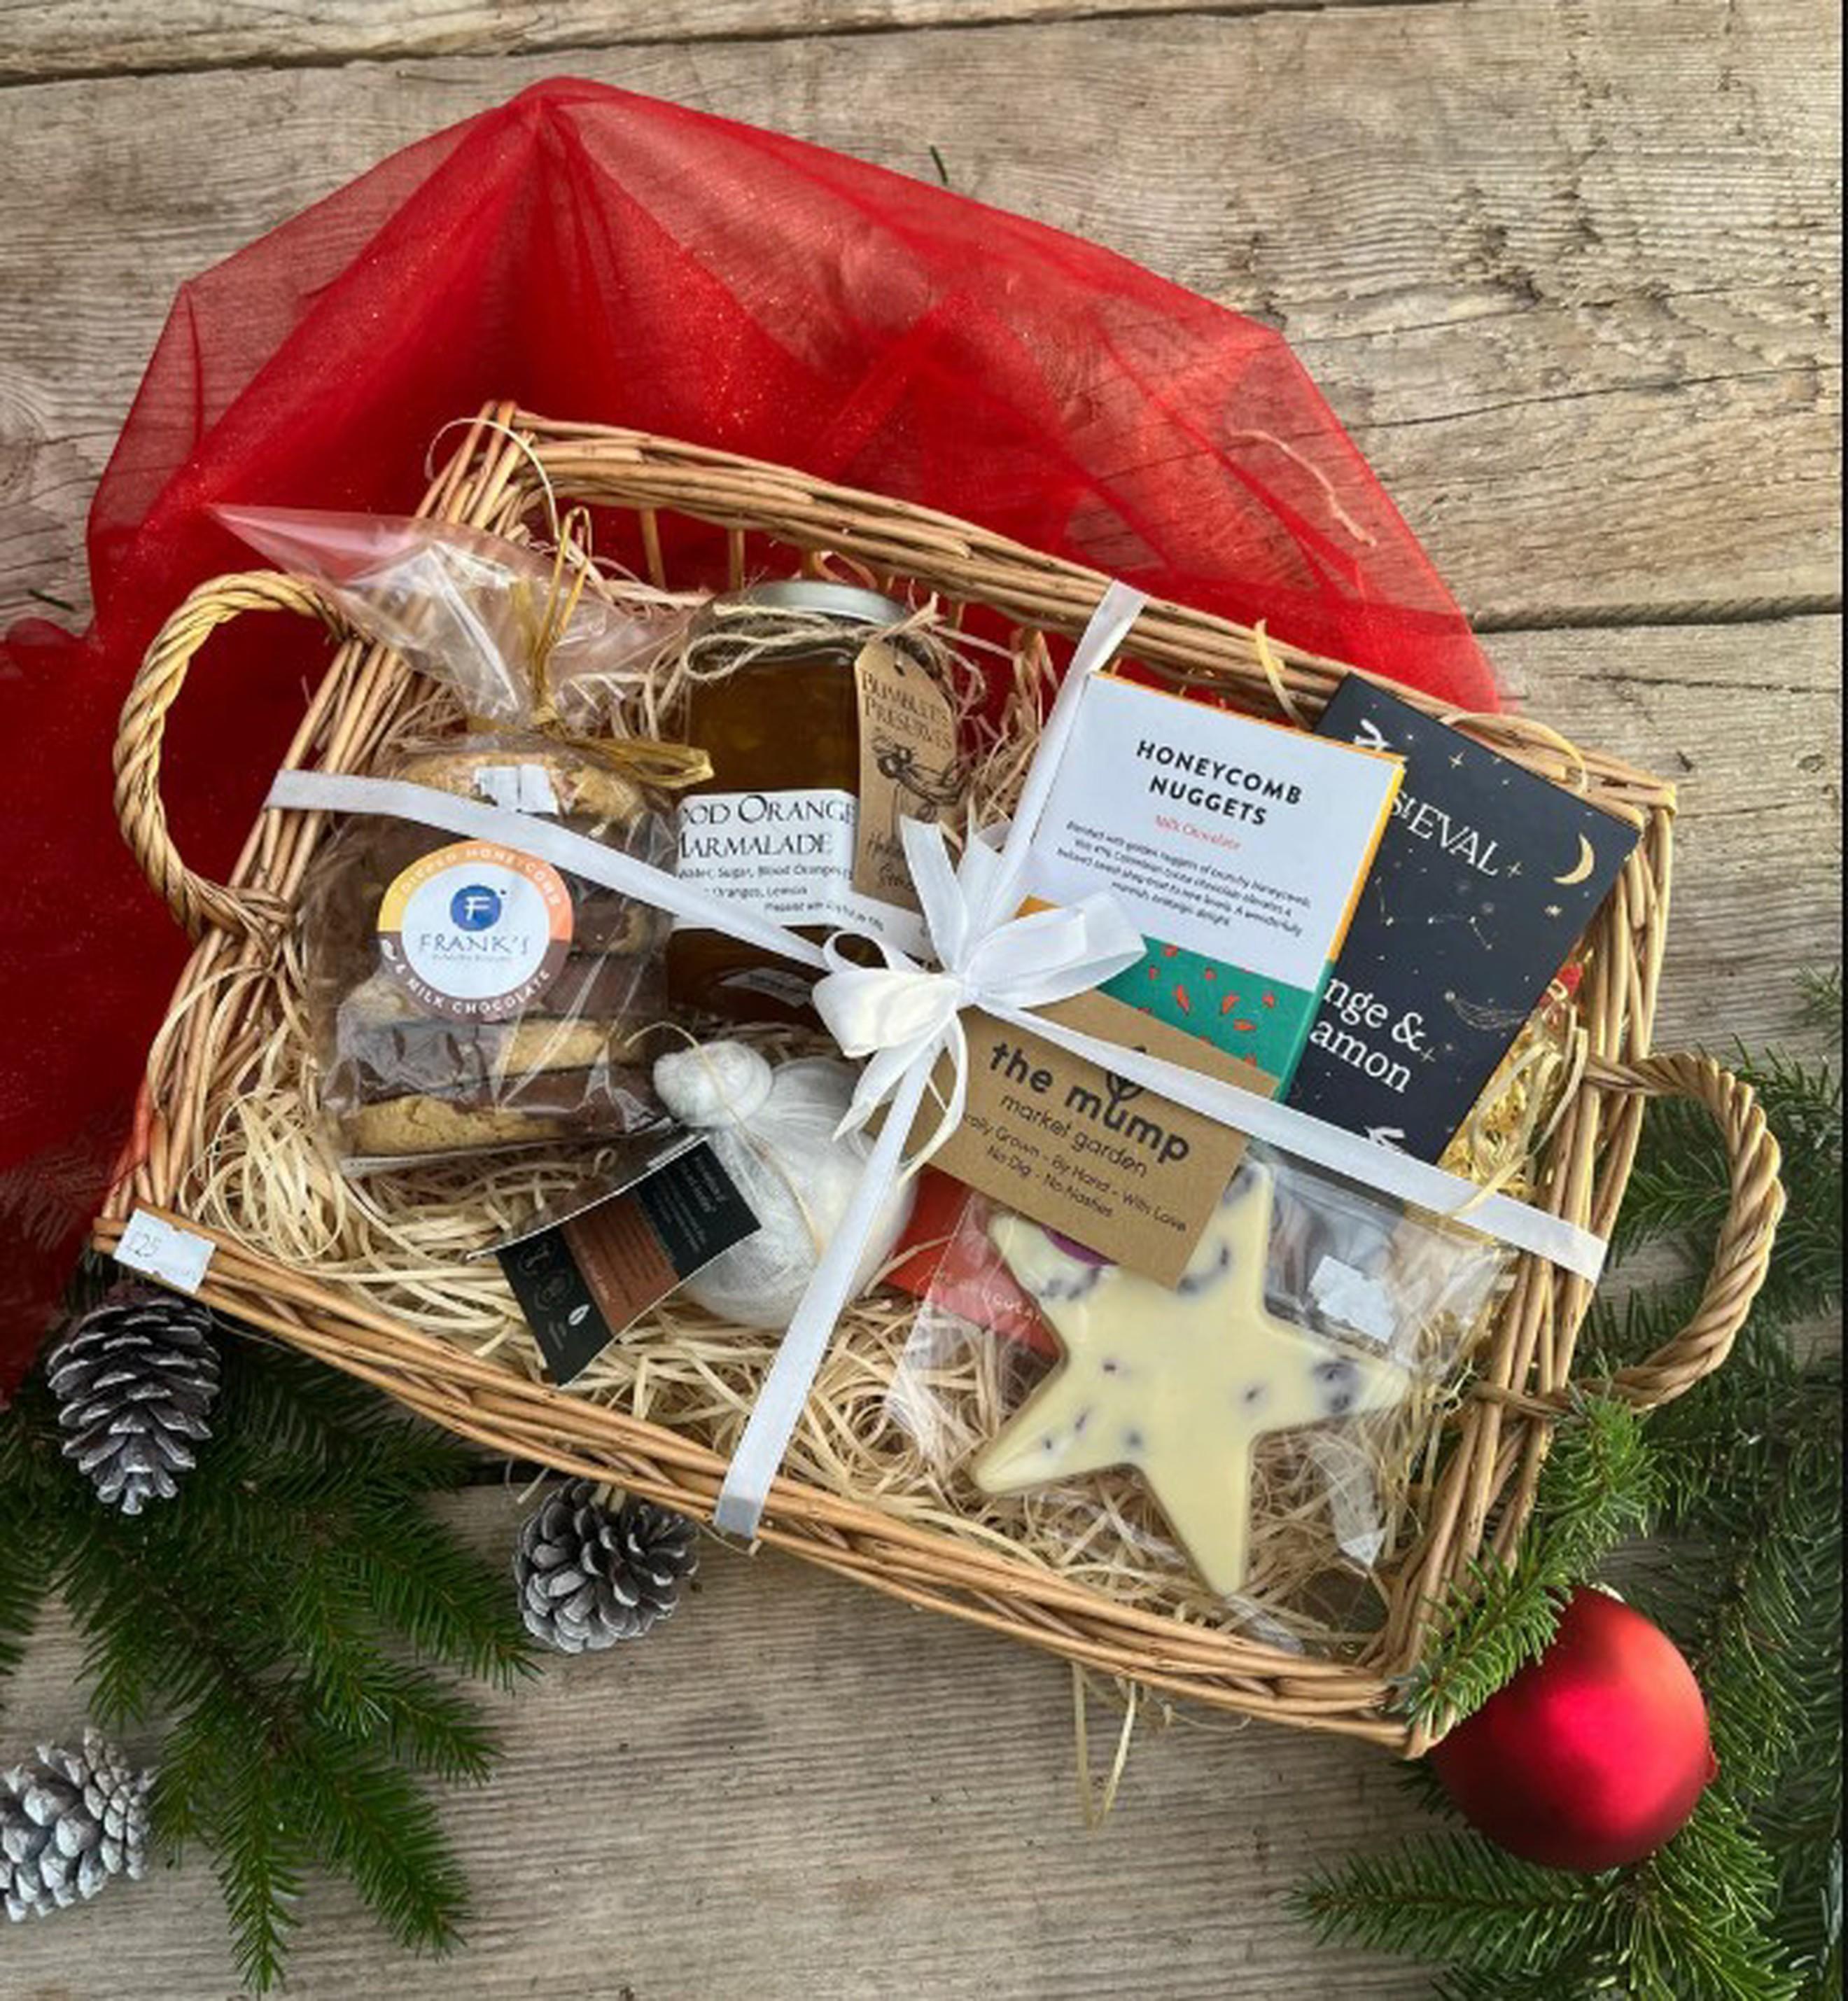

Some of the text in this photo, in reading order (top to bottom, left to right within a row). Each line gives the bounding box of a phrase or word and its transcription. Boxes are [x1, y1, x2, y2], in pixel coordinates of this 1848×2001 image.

[1136, 739, 1303, 805] HONEYCOMB
[1149, 775, 1268, 825] NUGGETS
[419, 933, 531, 956] FRANK'S
[406, 977, 444, 1009] MILK
[451, 968, 550, 1015] CHOCOLATE
[1323, 978, 1427, 1052] nge &
[1309, 1020, 1411, 1094] amon
[990, 1043, 1189, 1164] the mump
[999, 1095, 1147, 1178] market garden
[987, 1145, 1007, 1164] No
[1007, 1155, 1032, 1178] Dig
[1043, 1173, 1063, 1192] No
[1063, 1185, 1114, 1218] Nasties
[995, 1126, 1040, 1157] Grown
[1052, 1154, 1071, 1174] By
[1072, 1165, 1110, 1193] Hand
[1154, 1206, 1187, 1232] Love
